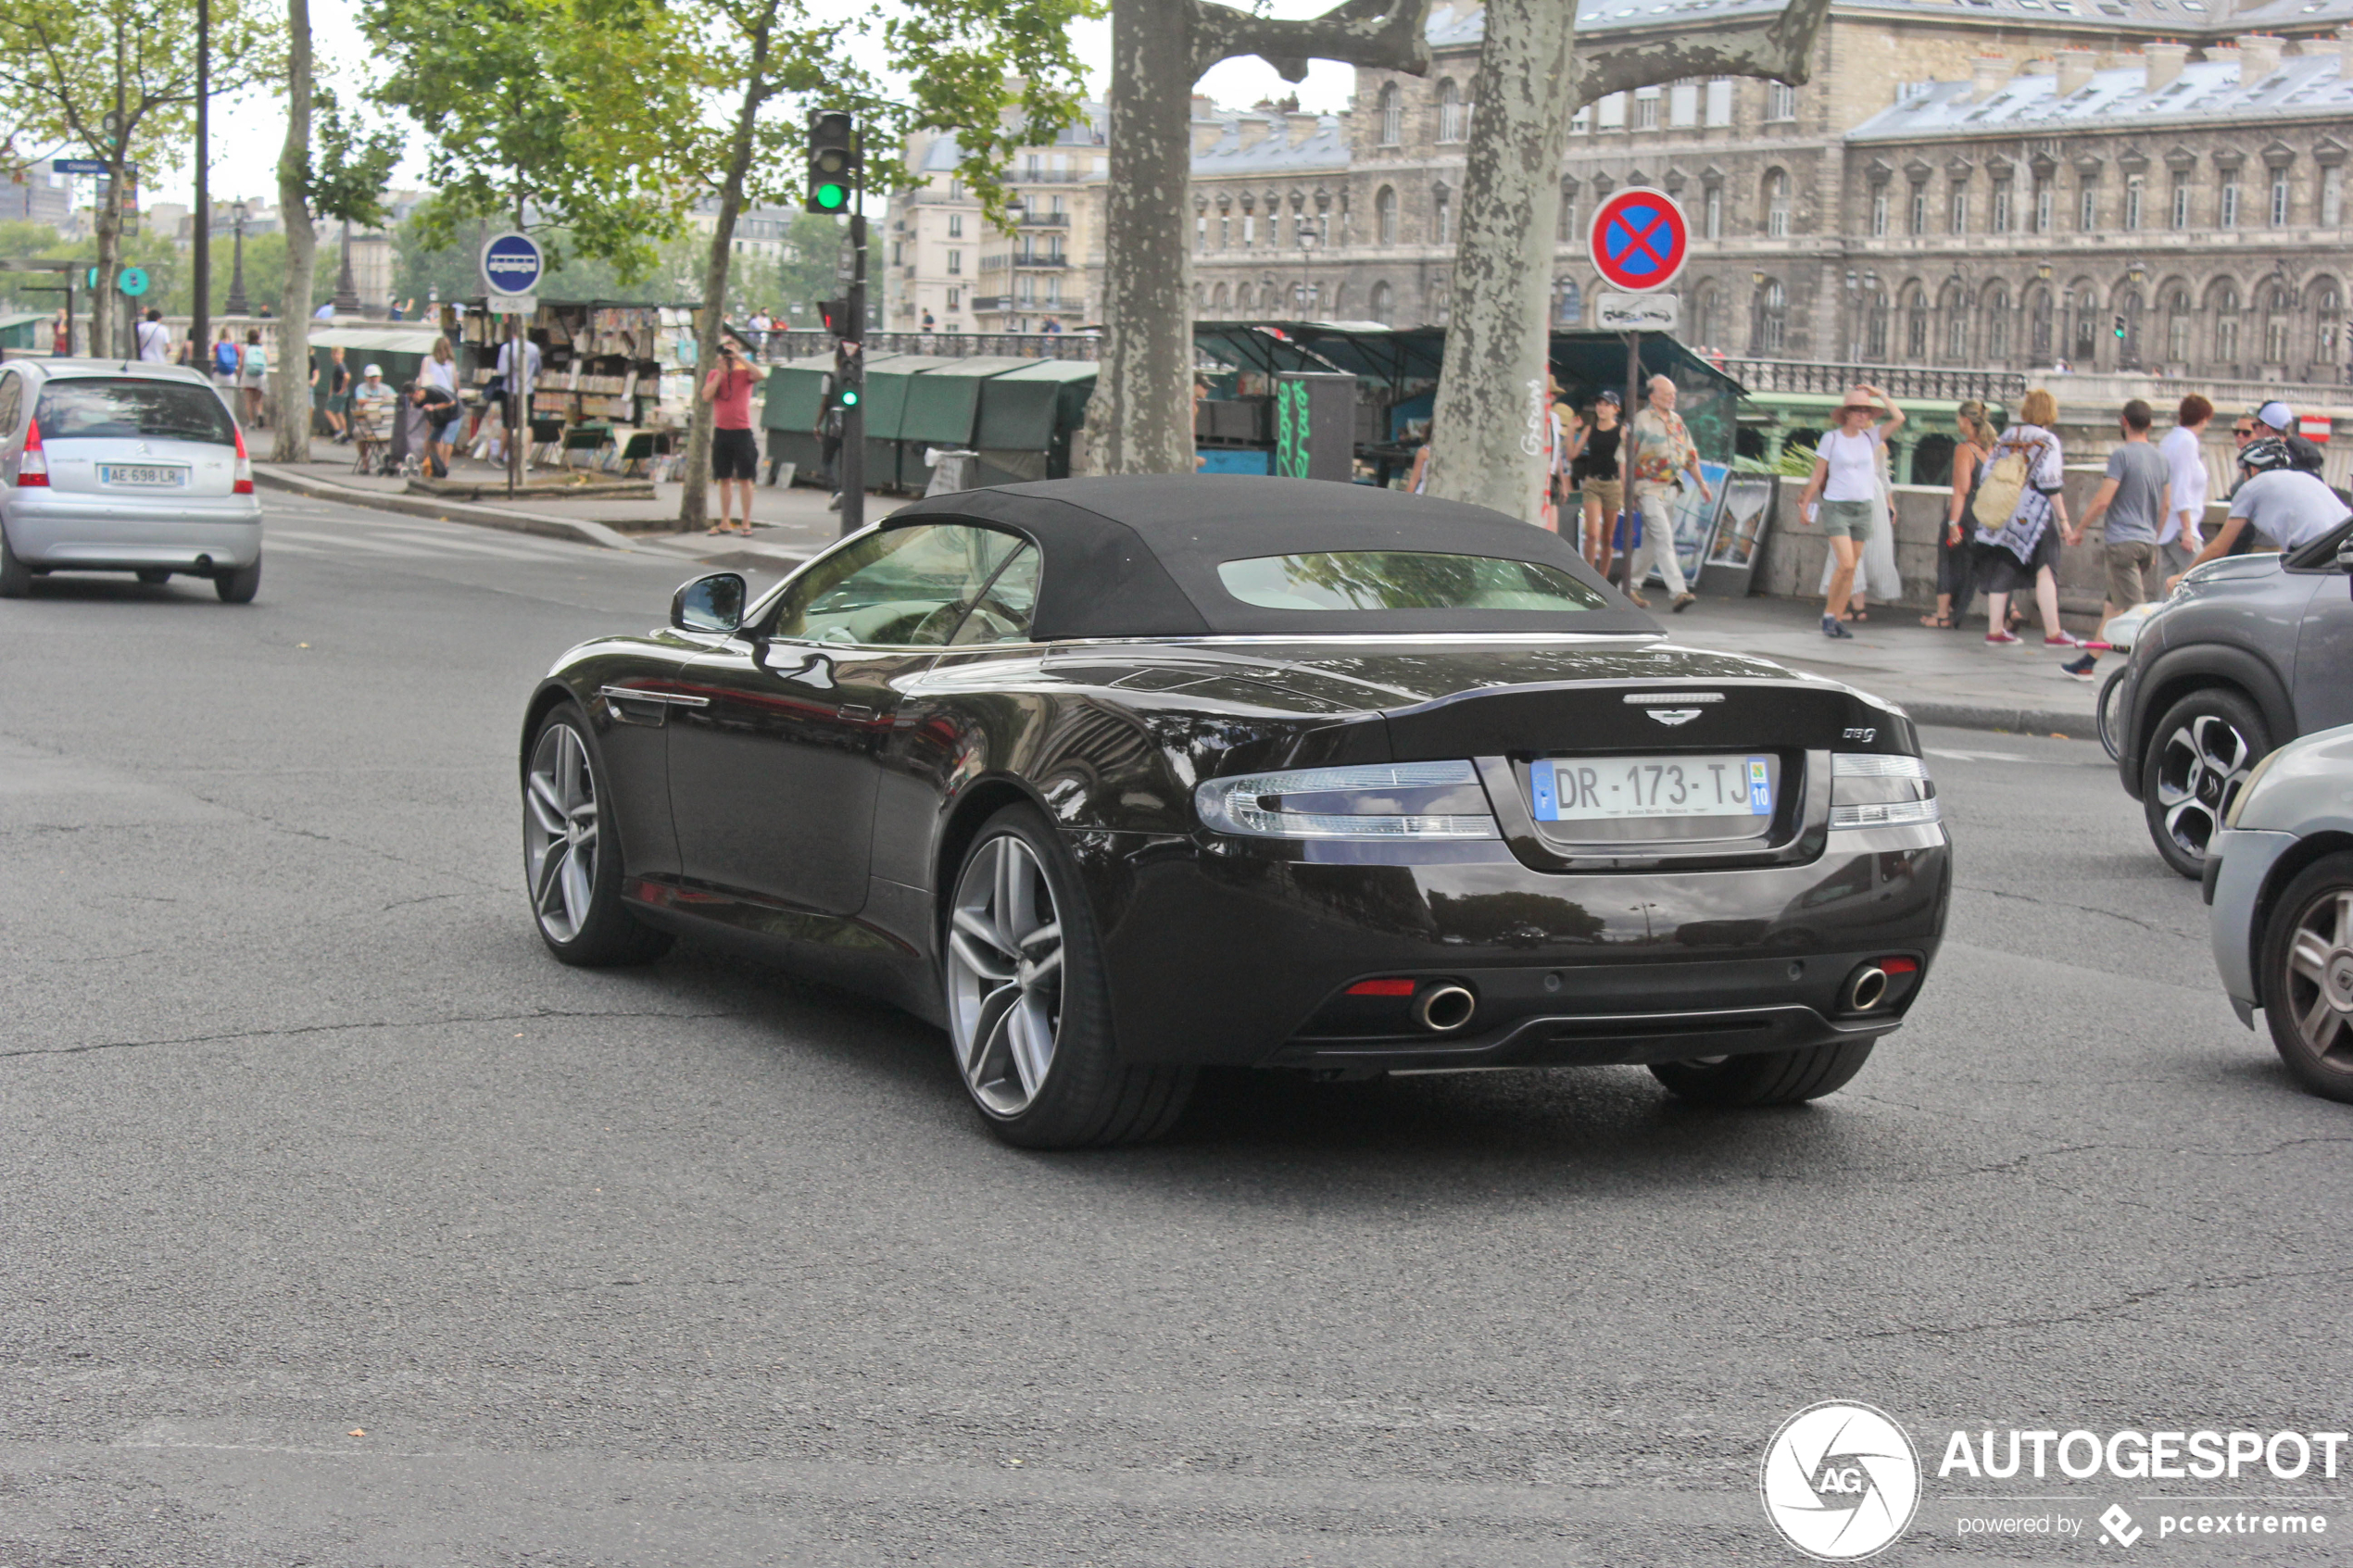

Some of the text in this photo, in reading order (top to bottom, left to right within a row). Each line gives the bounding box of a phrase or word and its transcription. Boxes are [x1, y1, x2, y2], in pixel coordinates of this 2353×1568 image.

[111, 469, 176, 483] AE-698-LR
[1843, 728, 1876, 743] DB9
[1752, 787, 1769, 807] 10
